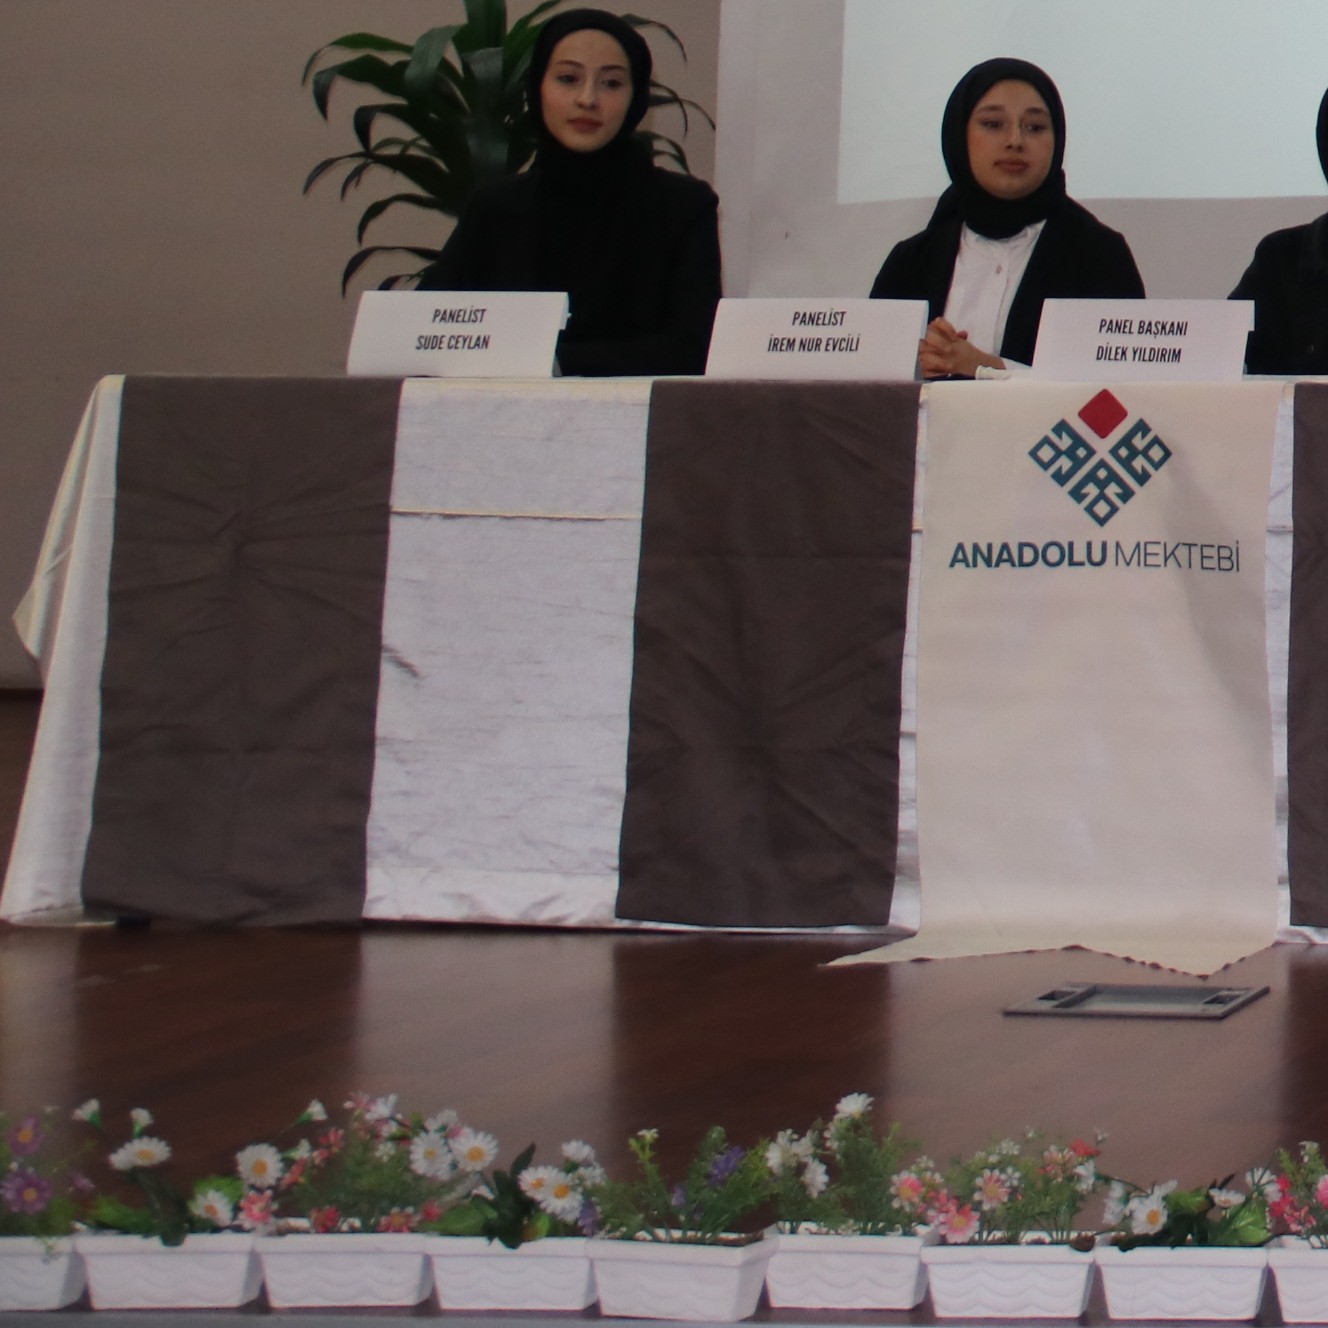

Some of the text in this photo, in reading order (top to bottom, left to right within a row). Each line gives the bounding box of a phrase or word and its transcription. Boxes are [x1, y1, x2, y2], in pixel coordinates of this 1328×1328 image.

[432, 305, 487, 323] PANELİST
[792, 307, 847, 326] PANELİST
[1098, 318, 1188, 339] PANEL BAŞKANI
[415, 334, 491, 350] SUDE CEYLAN
[767, 333, 861, 352] İREM NUR EVCİLİ
[1096, 342, 1182, 363] DİLEK YILDIRIM
[949, 540, 1240, 573] ANADOLU MEKTEBİ
